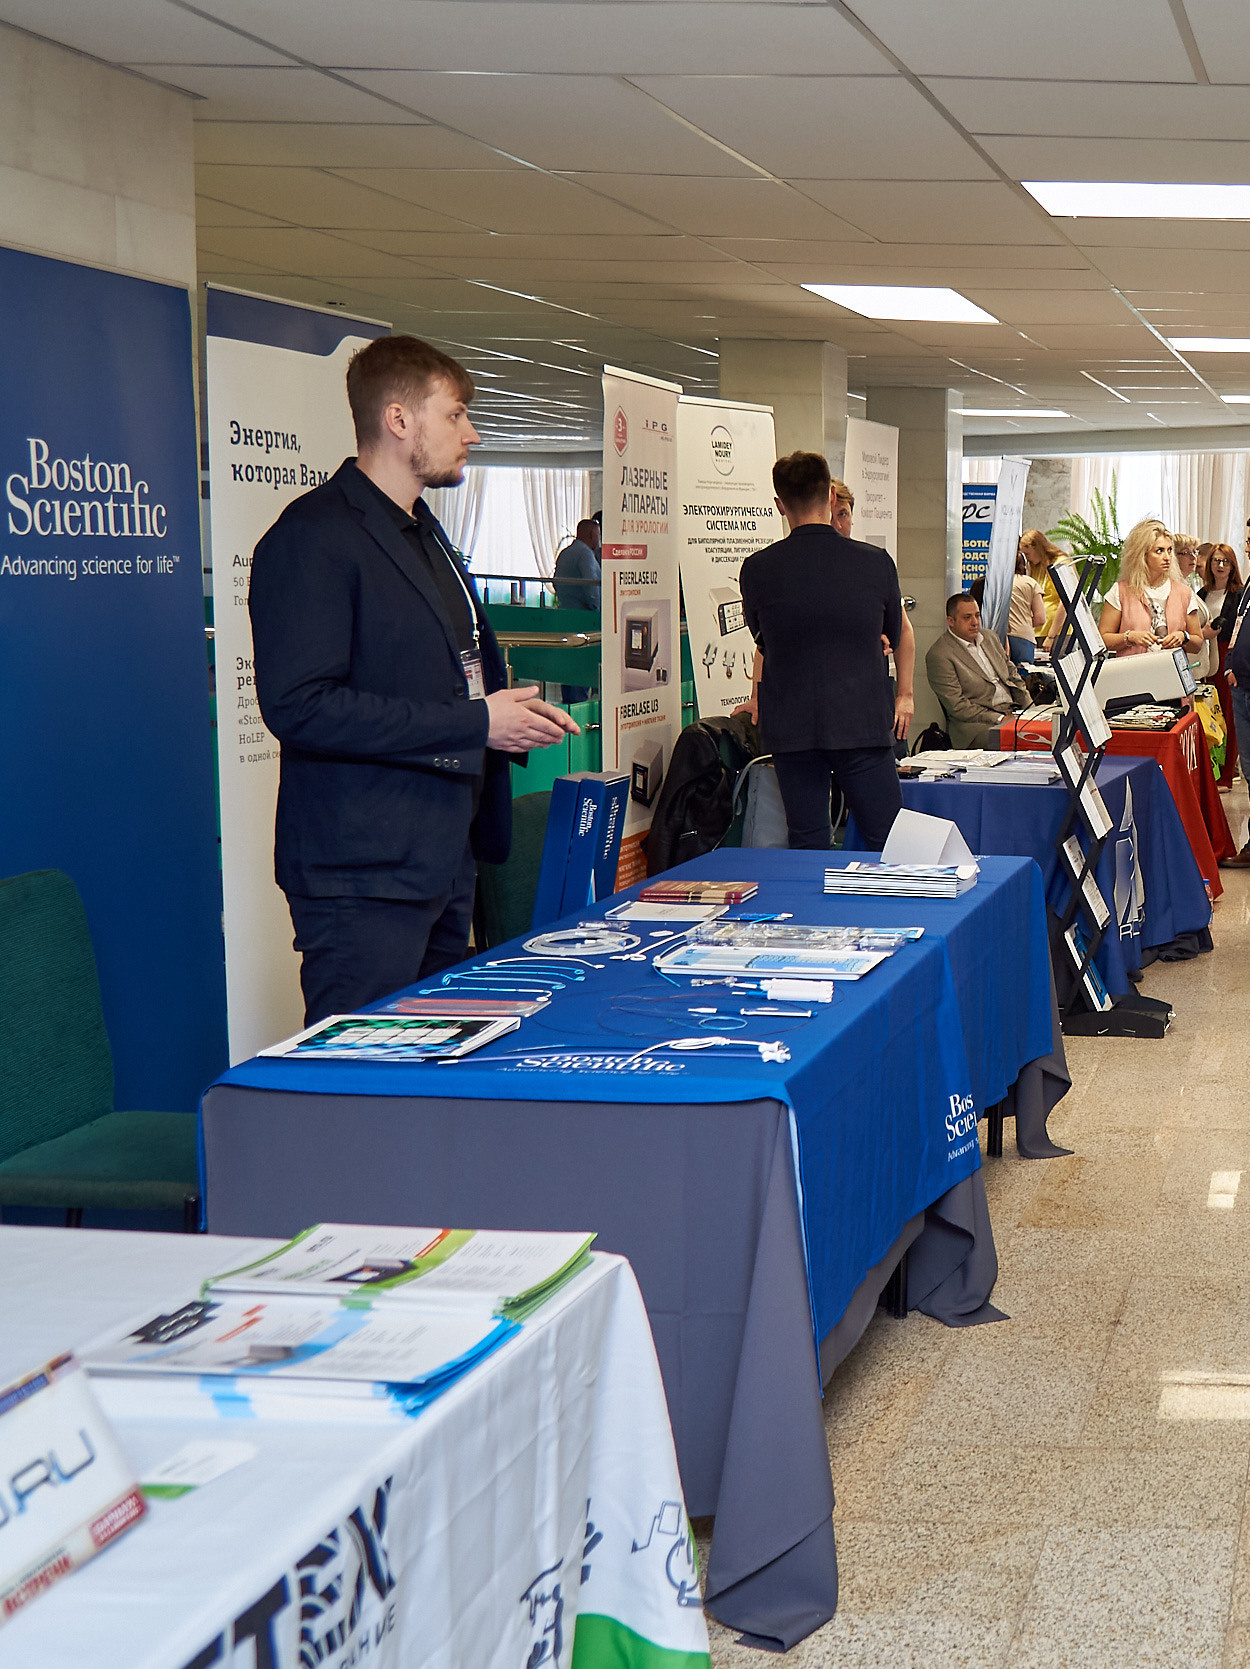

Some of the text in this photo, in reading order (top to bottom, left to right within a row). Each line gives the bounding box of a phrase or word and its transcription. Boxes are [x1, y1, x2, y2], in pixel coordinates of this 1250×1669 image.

[229, 420, 301, 454] Энергия,
[711, 441, 732, 450] LAMIDEY
[714, 450, 731, 458] NOURY
[27, 438, 133, 493] Boston
[231, 464, 296, 490] которая
[621, 466, 668, 490] ЛАЗЕРНЫЕ
[6, 474, 167, 538] Scientific
[621, 493, 668, 515] АППАРАТЫ
[683, 504, 773, 517] ЭЛЕКТРОХИРУРГИЧЕСКАЯ
[621, 519, 668, 535] ДЛЯ УРОЛОГИИ
[706, 519, 739, 531] СИСТЕМА
[0, 555, 77, 580] Advancing
[82, 555, 131, 574] science
[137, 555, 153, 574] for
[233, 577, 245, 587] 50
[720, 695, 750, 707] ТЕХНОЛОГИЯ
[239, 732, 265, 744] HoLEP
[239, 755, 245, 763] в
[247, 749, 271, 763] одной
[579, 797, 594, 837] Scientific
[586, 803, 598, 830] Boston
[516, 1056, 686, 1072] Scientific
[949, 1093, 974, 1118] Bos
